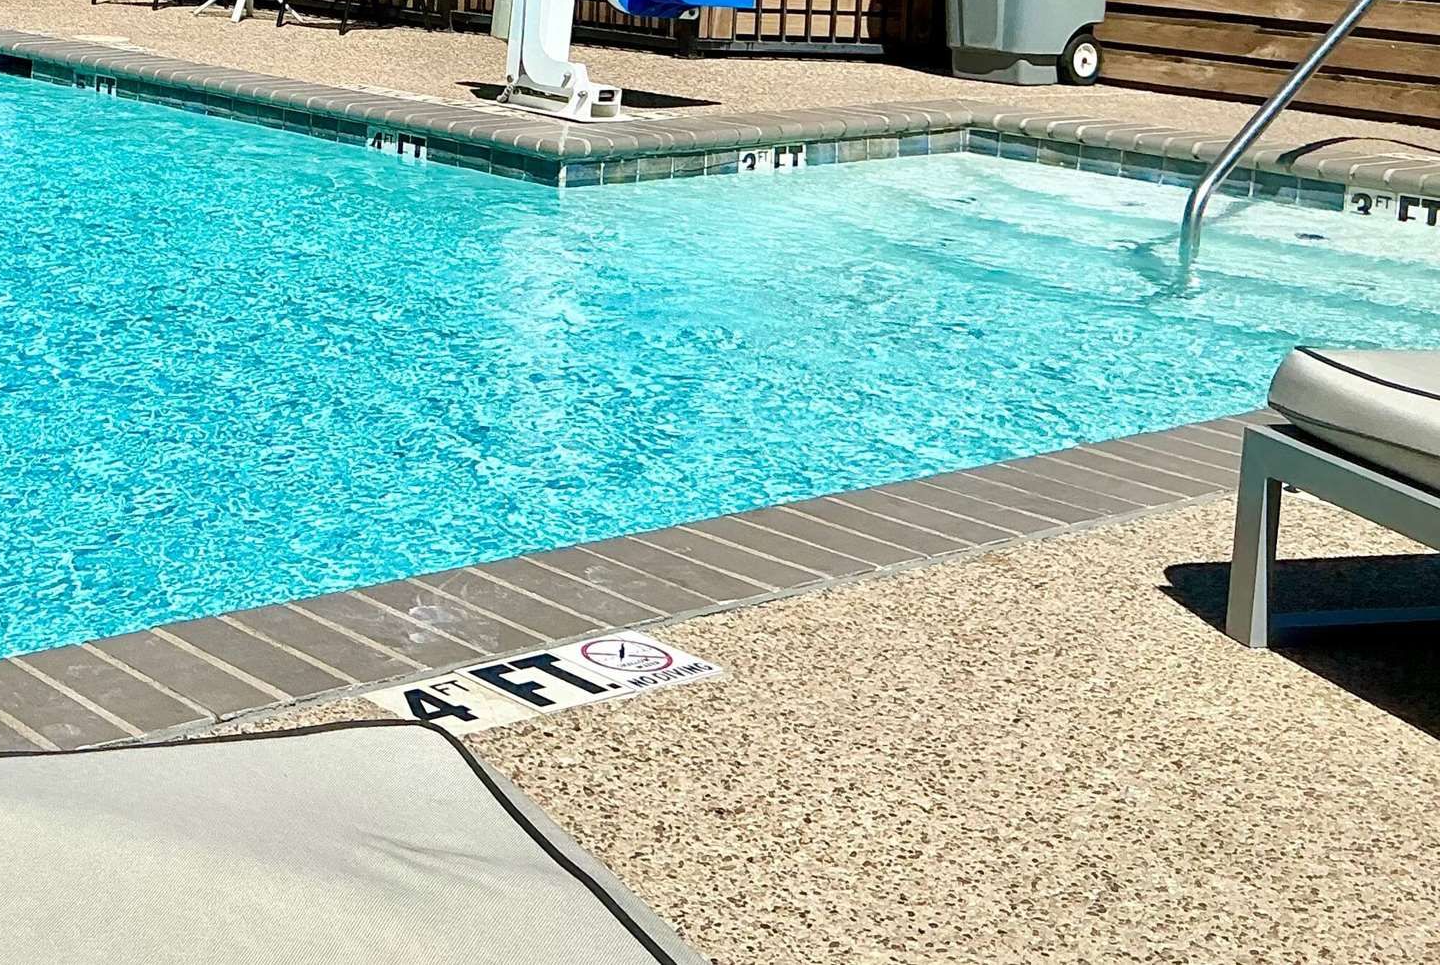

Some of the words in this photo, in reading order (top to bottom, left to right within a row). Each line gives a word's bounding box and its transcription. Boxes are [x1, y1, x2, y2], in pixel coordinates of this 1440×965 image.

[1375, 195, 1392, 209] FT
[430, 679, 470, 697] FT
[468, 652, 623, 707] FT.
[626, 675, 659, 688] NO
[653, 661, 713, 682] DIVING
[403, 688, 480, 722] 4
